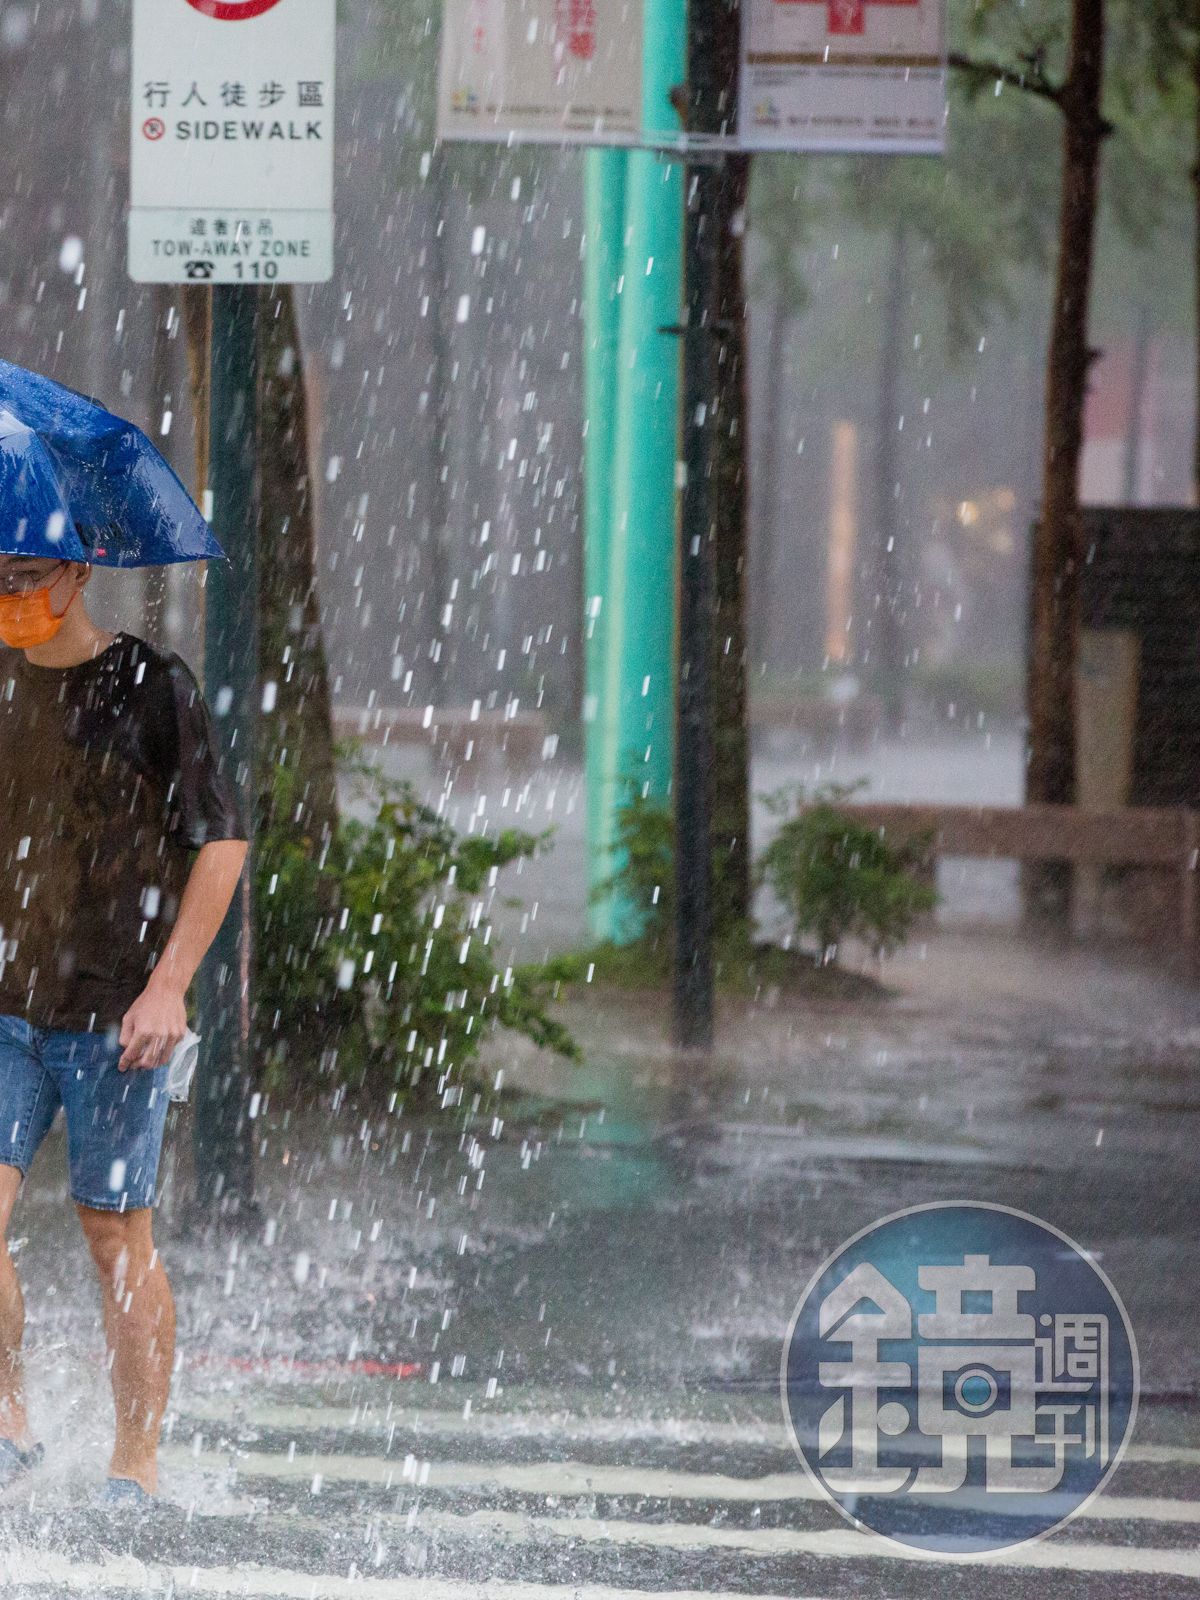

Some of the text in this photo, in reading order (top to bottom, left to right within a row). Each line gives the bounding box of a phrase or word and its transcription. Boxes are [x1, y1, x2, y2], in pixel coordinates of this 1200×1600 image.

[144, 80, 324, 108] 行人徒步區
[175, 120, 323, 141] SIDEWALK
[152, 239, 311, 257] TOW-AWAY ZONE
[233, 260, 278, 279] 110
